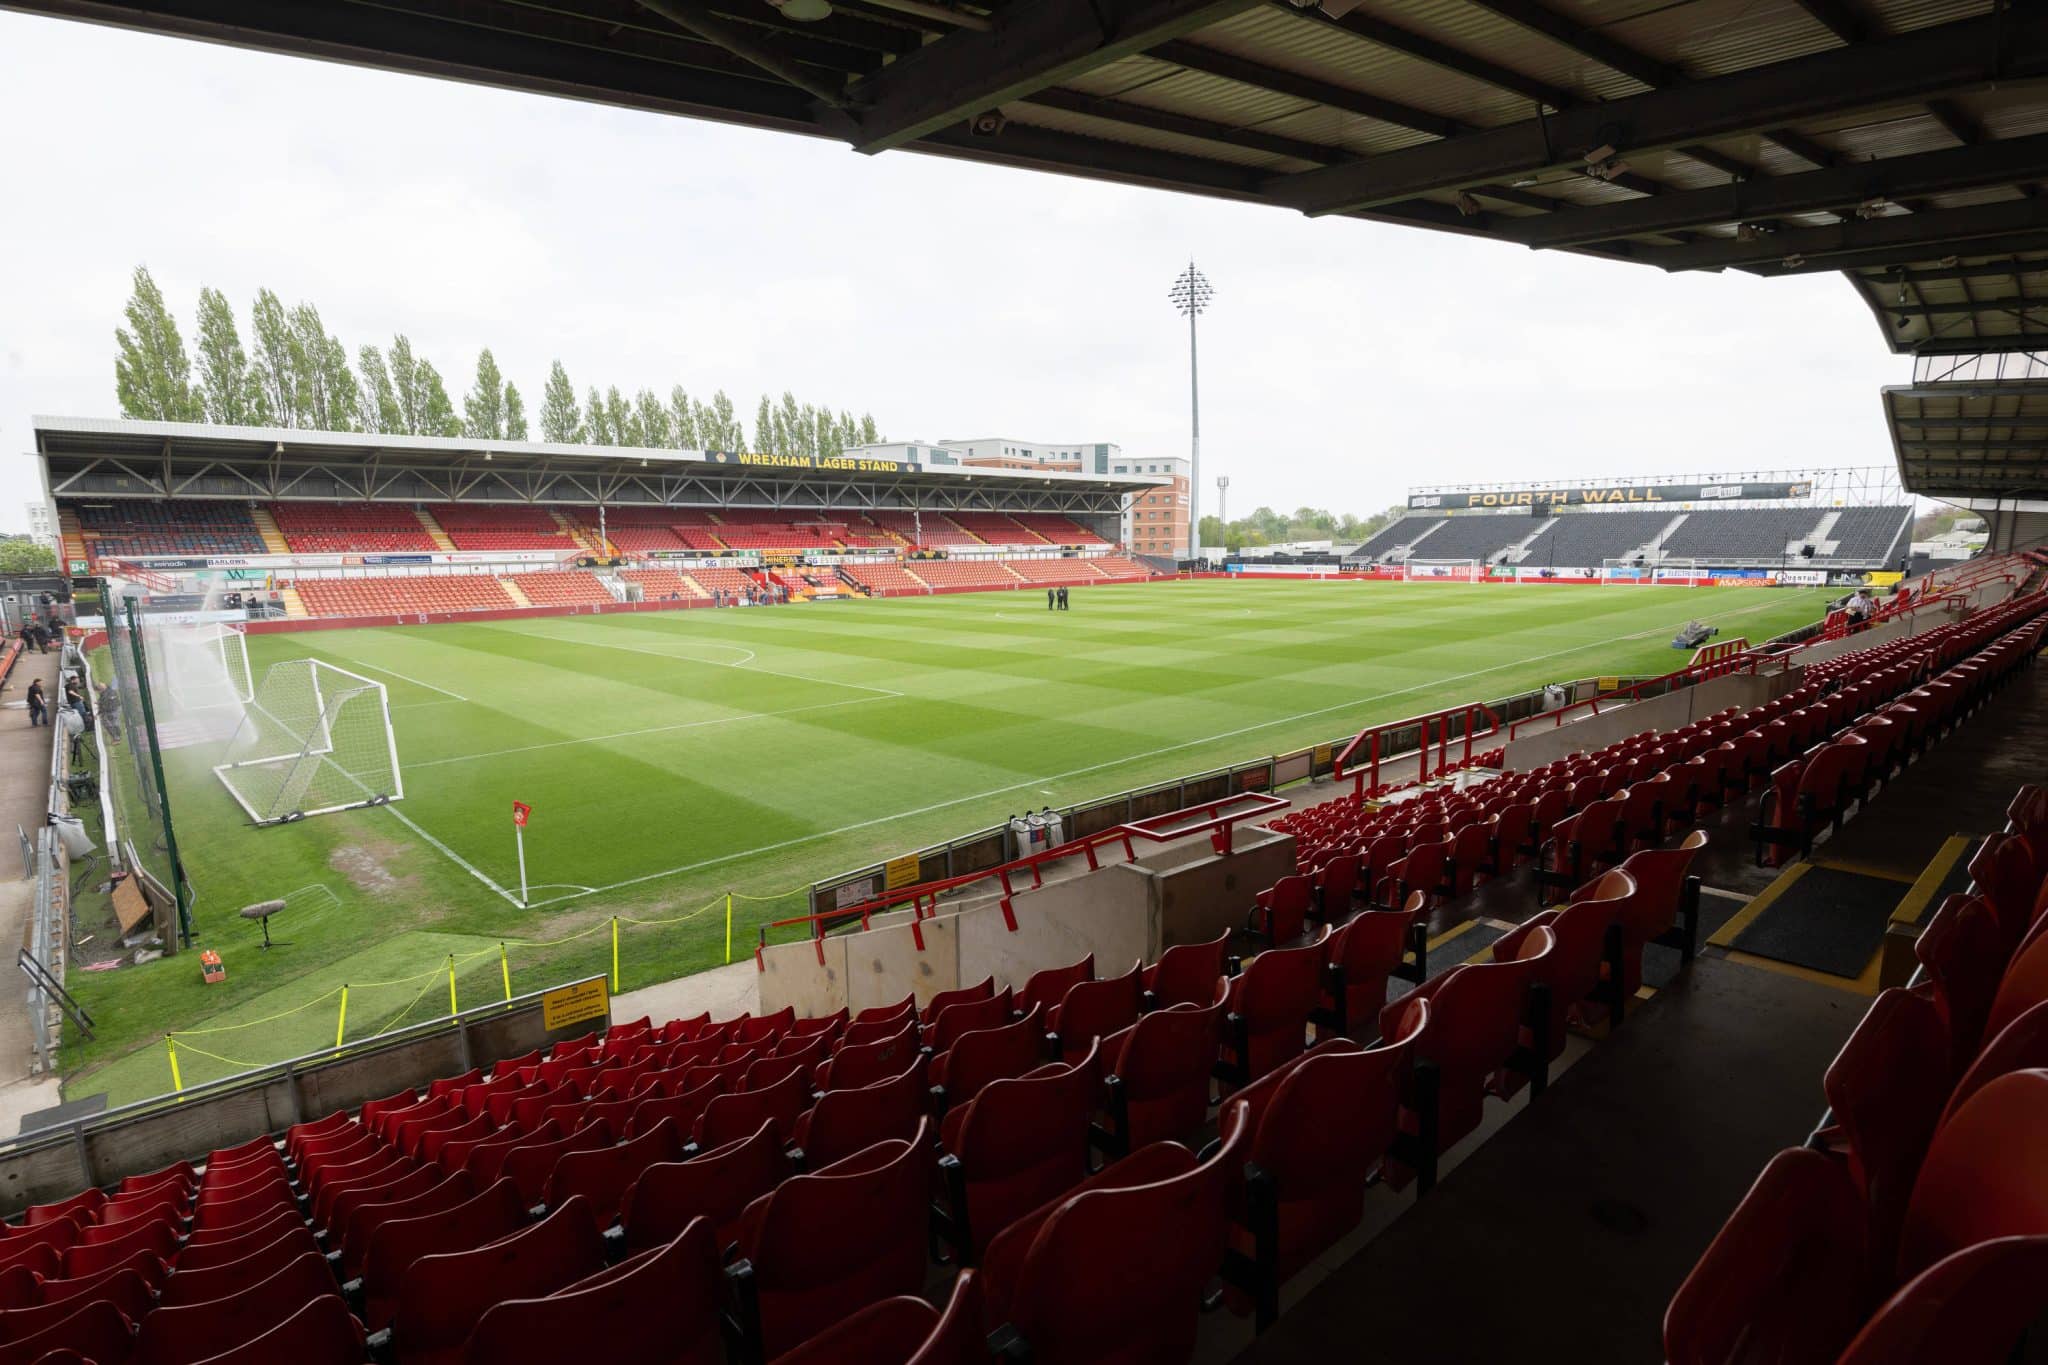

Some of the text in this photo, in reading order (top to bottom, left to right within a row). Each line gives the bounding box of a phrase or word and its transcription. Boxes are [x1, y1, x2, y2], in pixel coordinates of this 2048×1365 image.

[738, 453, 898, 472] WREXHAM LAGER STAND
[1468, 488, 1663, 507] FOURTH WALL
